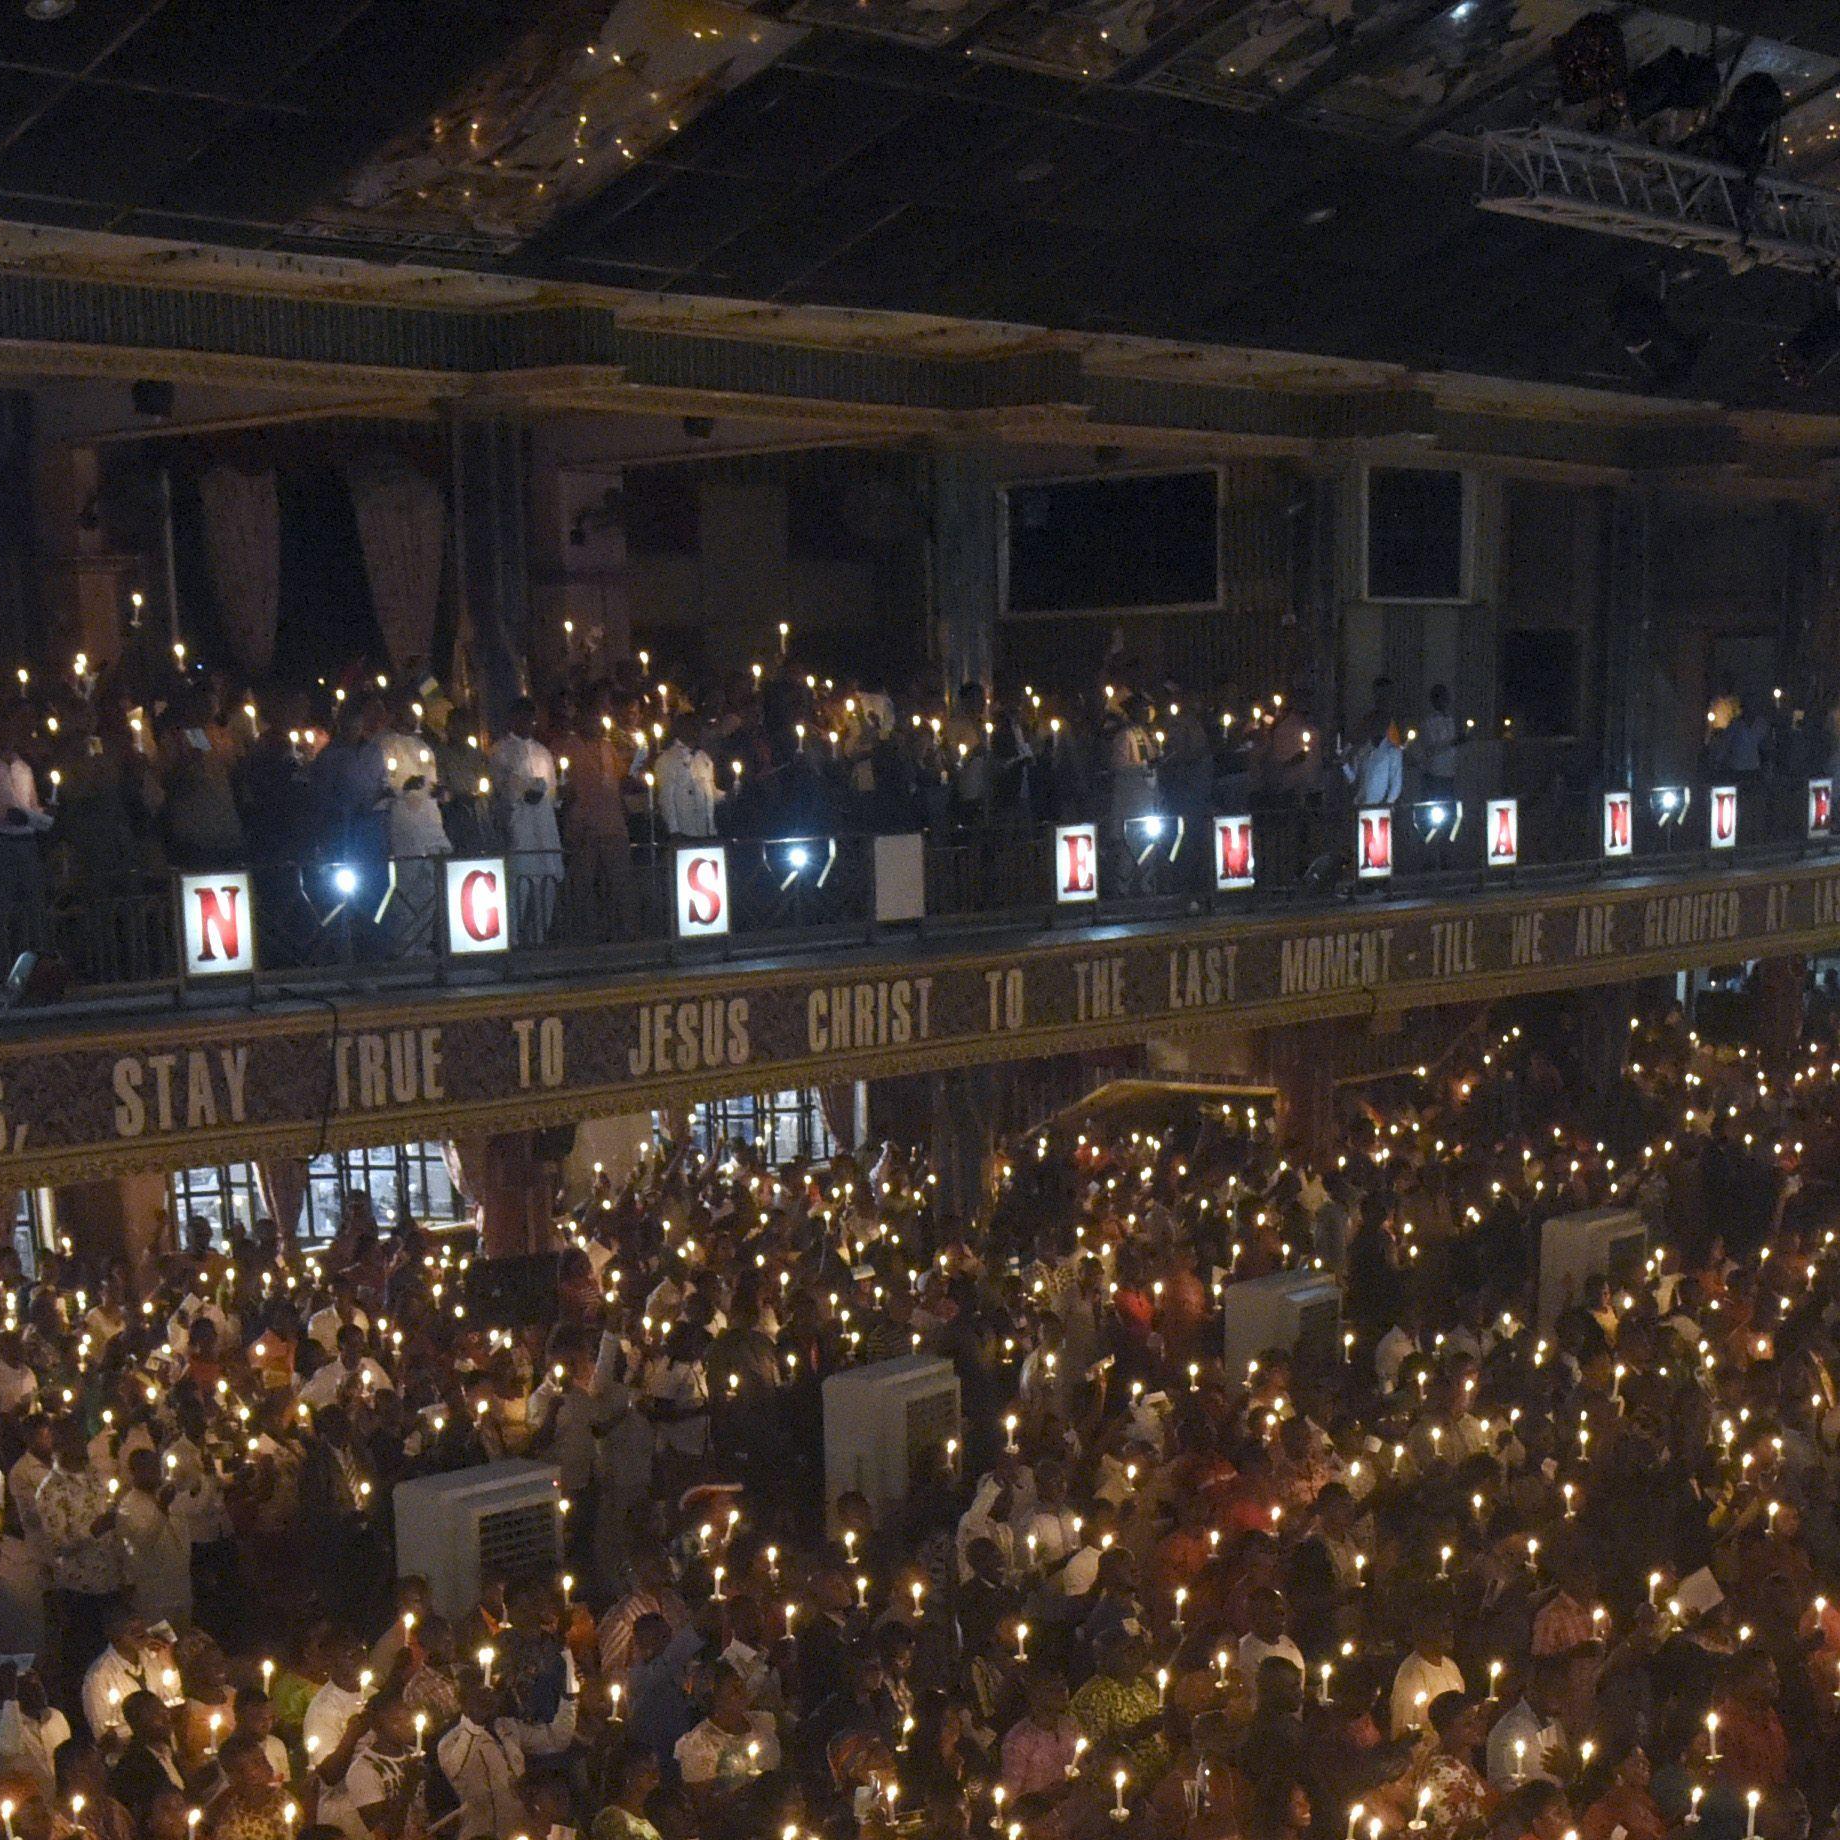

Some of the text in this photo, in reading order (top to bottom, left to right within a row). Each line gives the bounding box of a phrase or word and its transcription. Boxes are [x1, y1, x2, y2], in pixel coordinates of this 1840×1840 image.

[113, 1046, 252, 1138] STAY
[329, 1028, 445, 1110] TRUE
[512, 1017, 564, 1089] TO
[628, 998, 750, 1077] JESUS
[808, 977, 933, 1053] CHRIST
[985, 968, 1025, 1031] TO
[1072, 957, 1126, 1022] THE
[1169, 945, 1238, 1009] LAST
[1281, 927, 1395, 994] MOMENT
[1429, 920, 1476, 977] TILL
[1510, 911, 1546, 967] WE
[1574, 904, 1617, 957] ARE
[1642, 889, 1741, 947] GLORIFIED
[1765, 883, 1792, 932] AT
